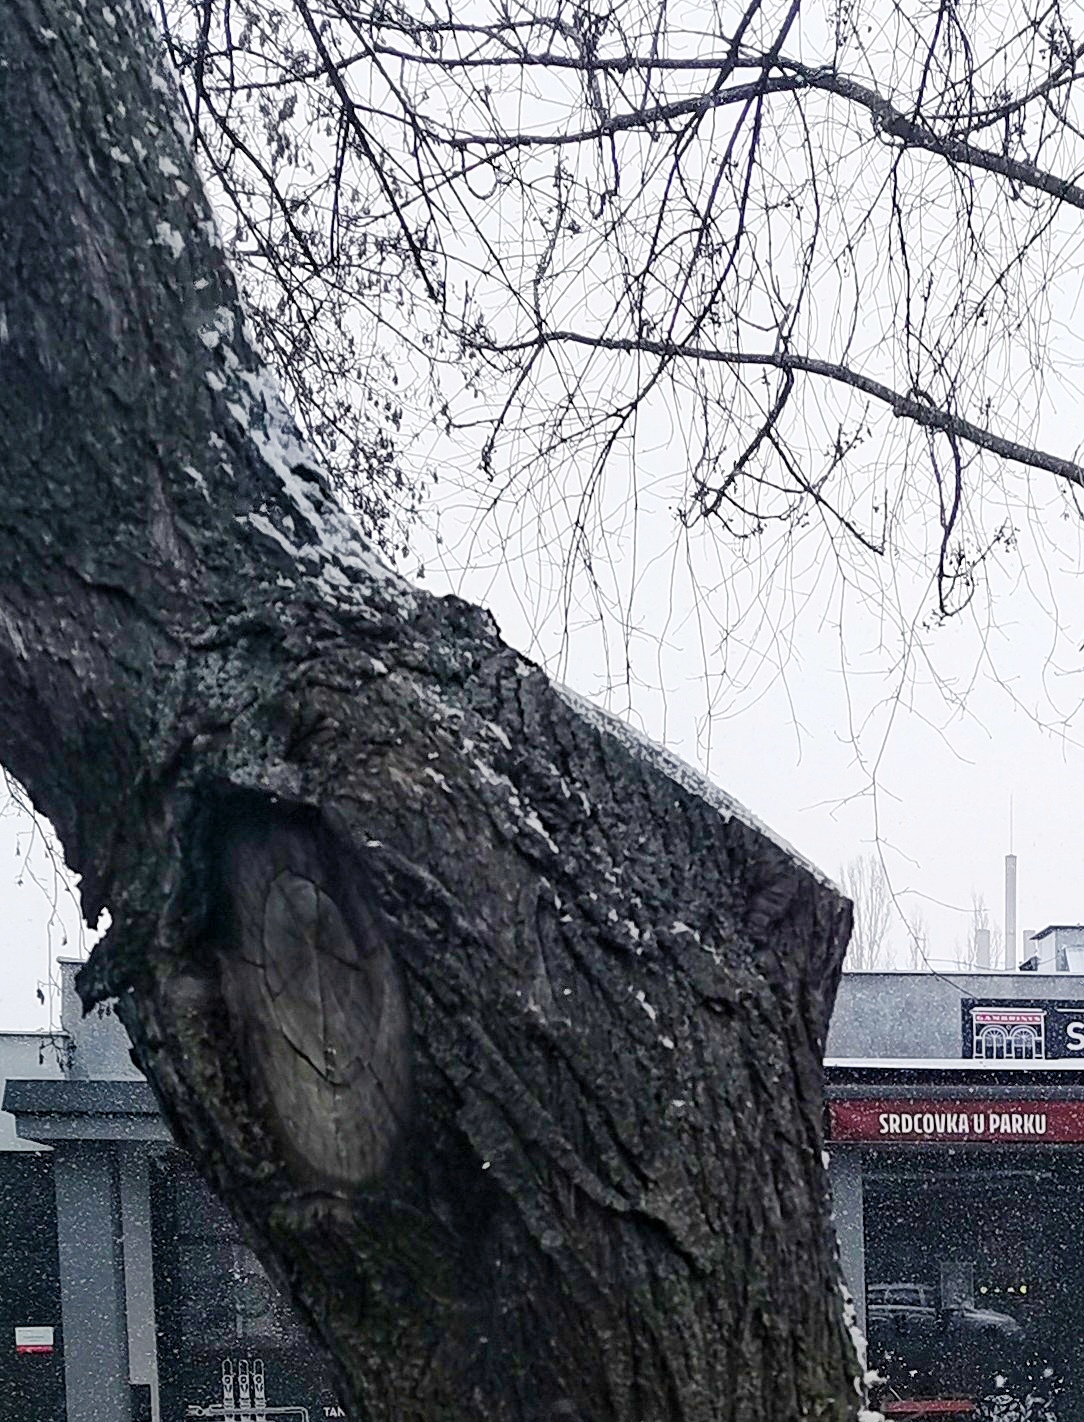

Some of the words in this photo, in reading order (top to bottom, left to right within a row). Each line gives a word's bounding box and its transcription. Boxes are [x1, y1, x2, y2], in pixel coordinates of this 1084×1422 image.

[879, 1113, 969, 1134] SRDCOVKA
[973, 1113, 985, 1134] U
[989, 1113, 1047, 1135] PARKU
